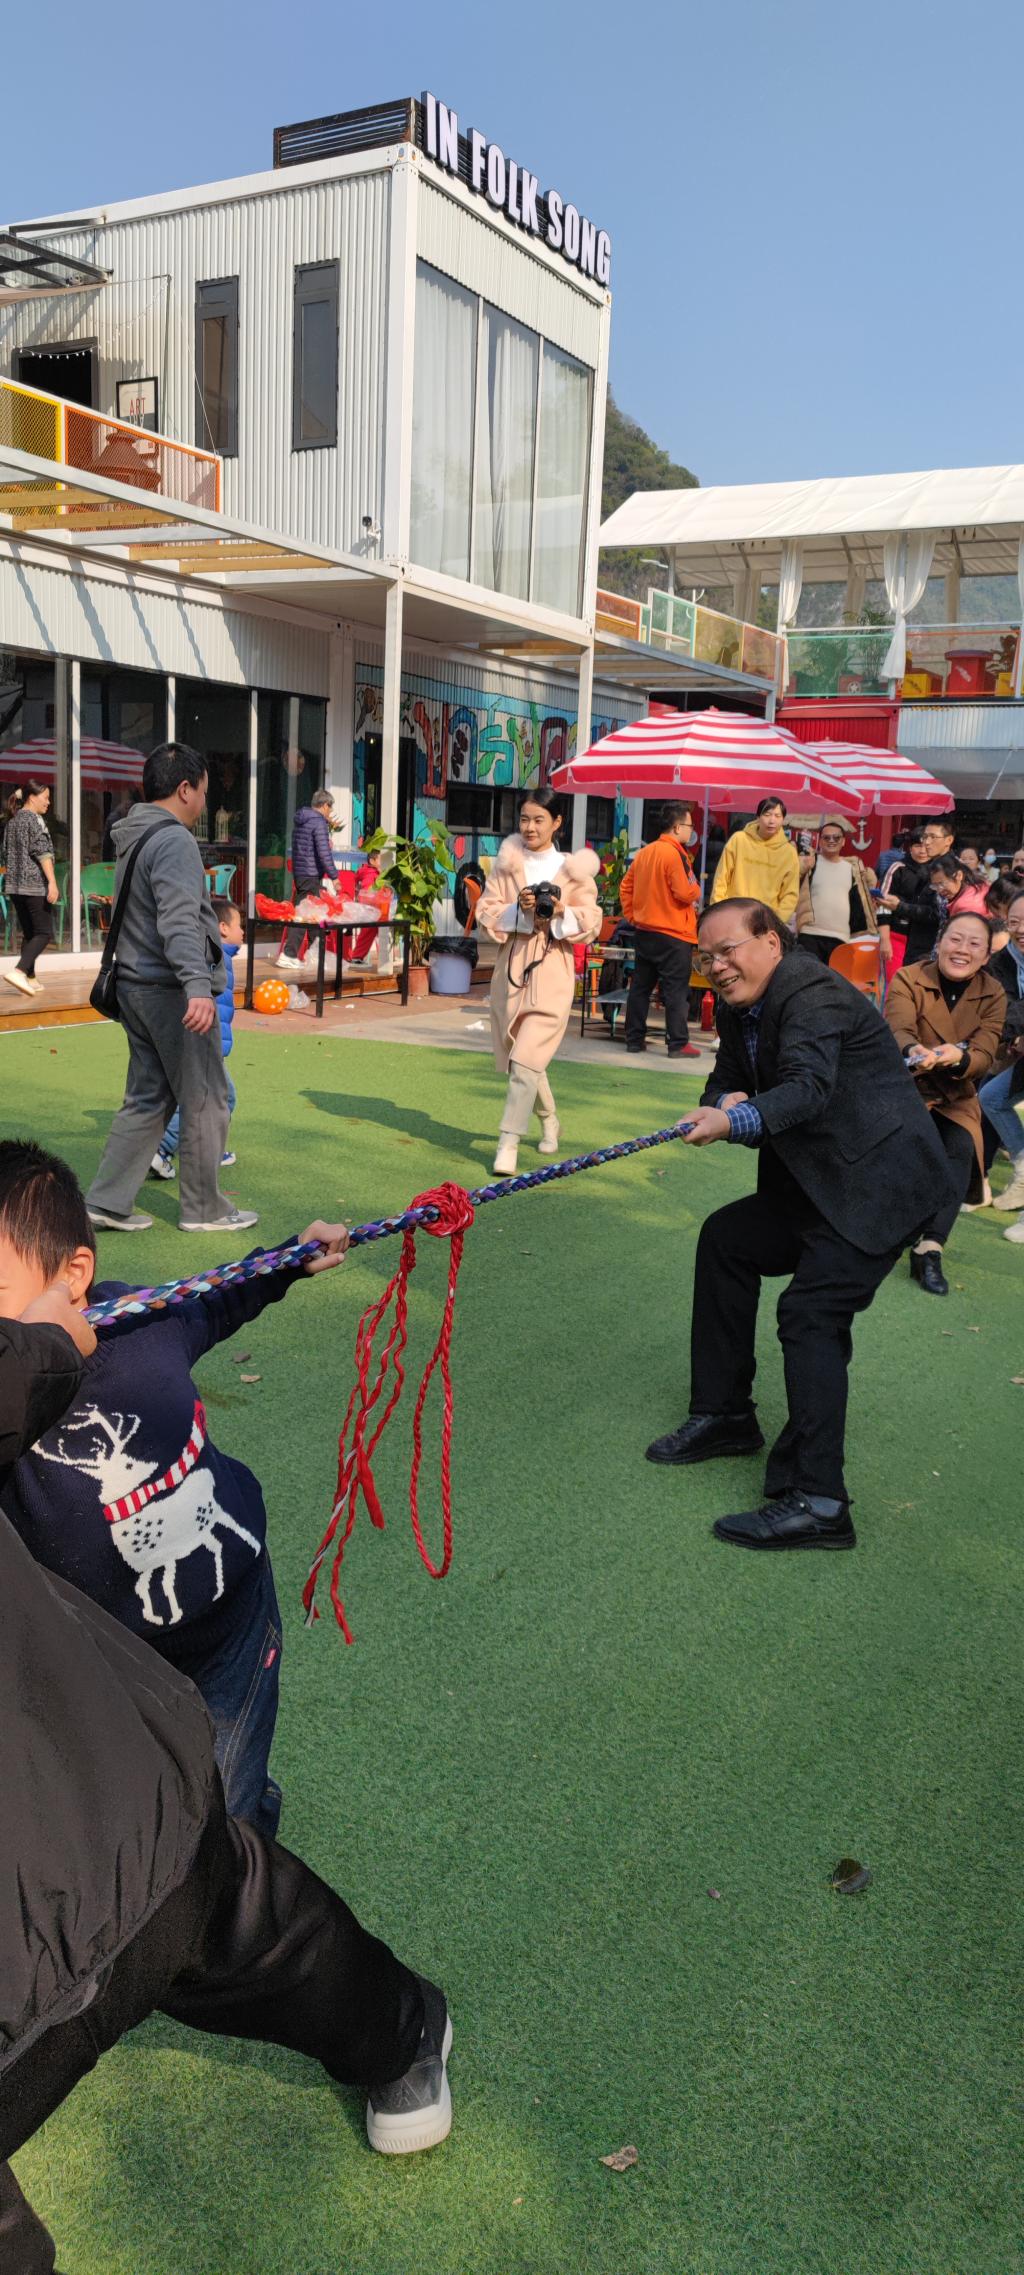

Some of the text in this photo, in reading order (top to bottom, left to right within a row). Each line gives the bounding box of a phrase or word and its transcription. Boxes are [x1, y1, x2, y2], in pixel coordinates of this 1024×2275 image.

[422, 91, 611, 285] IN FOLK SONG
[129, 397, 146, 416] ART
